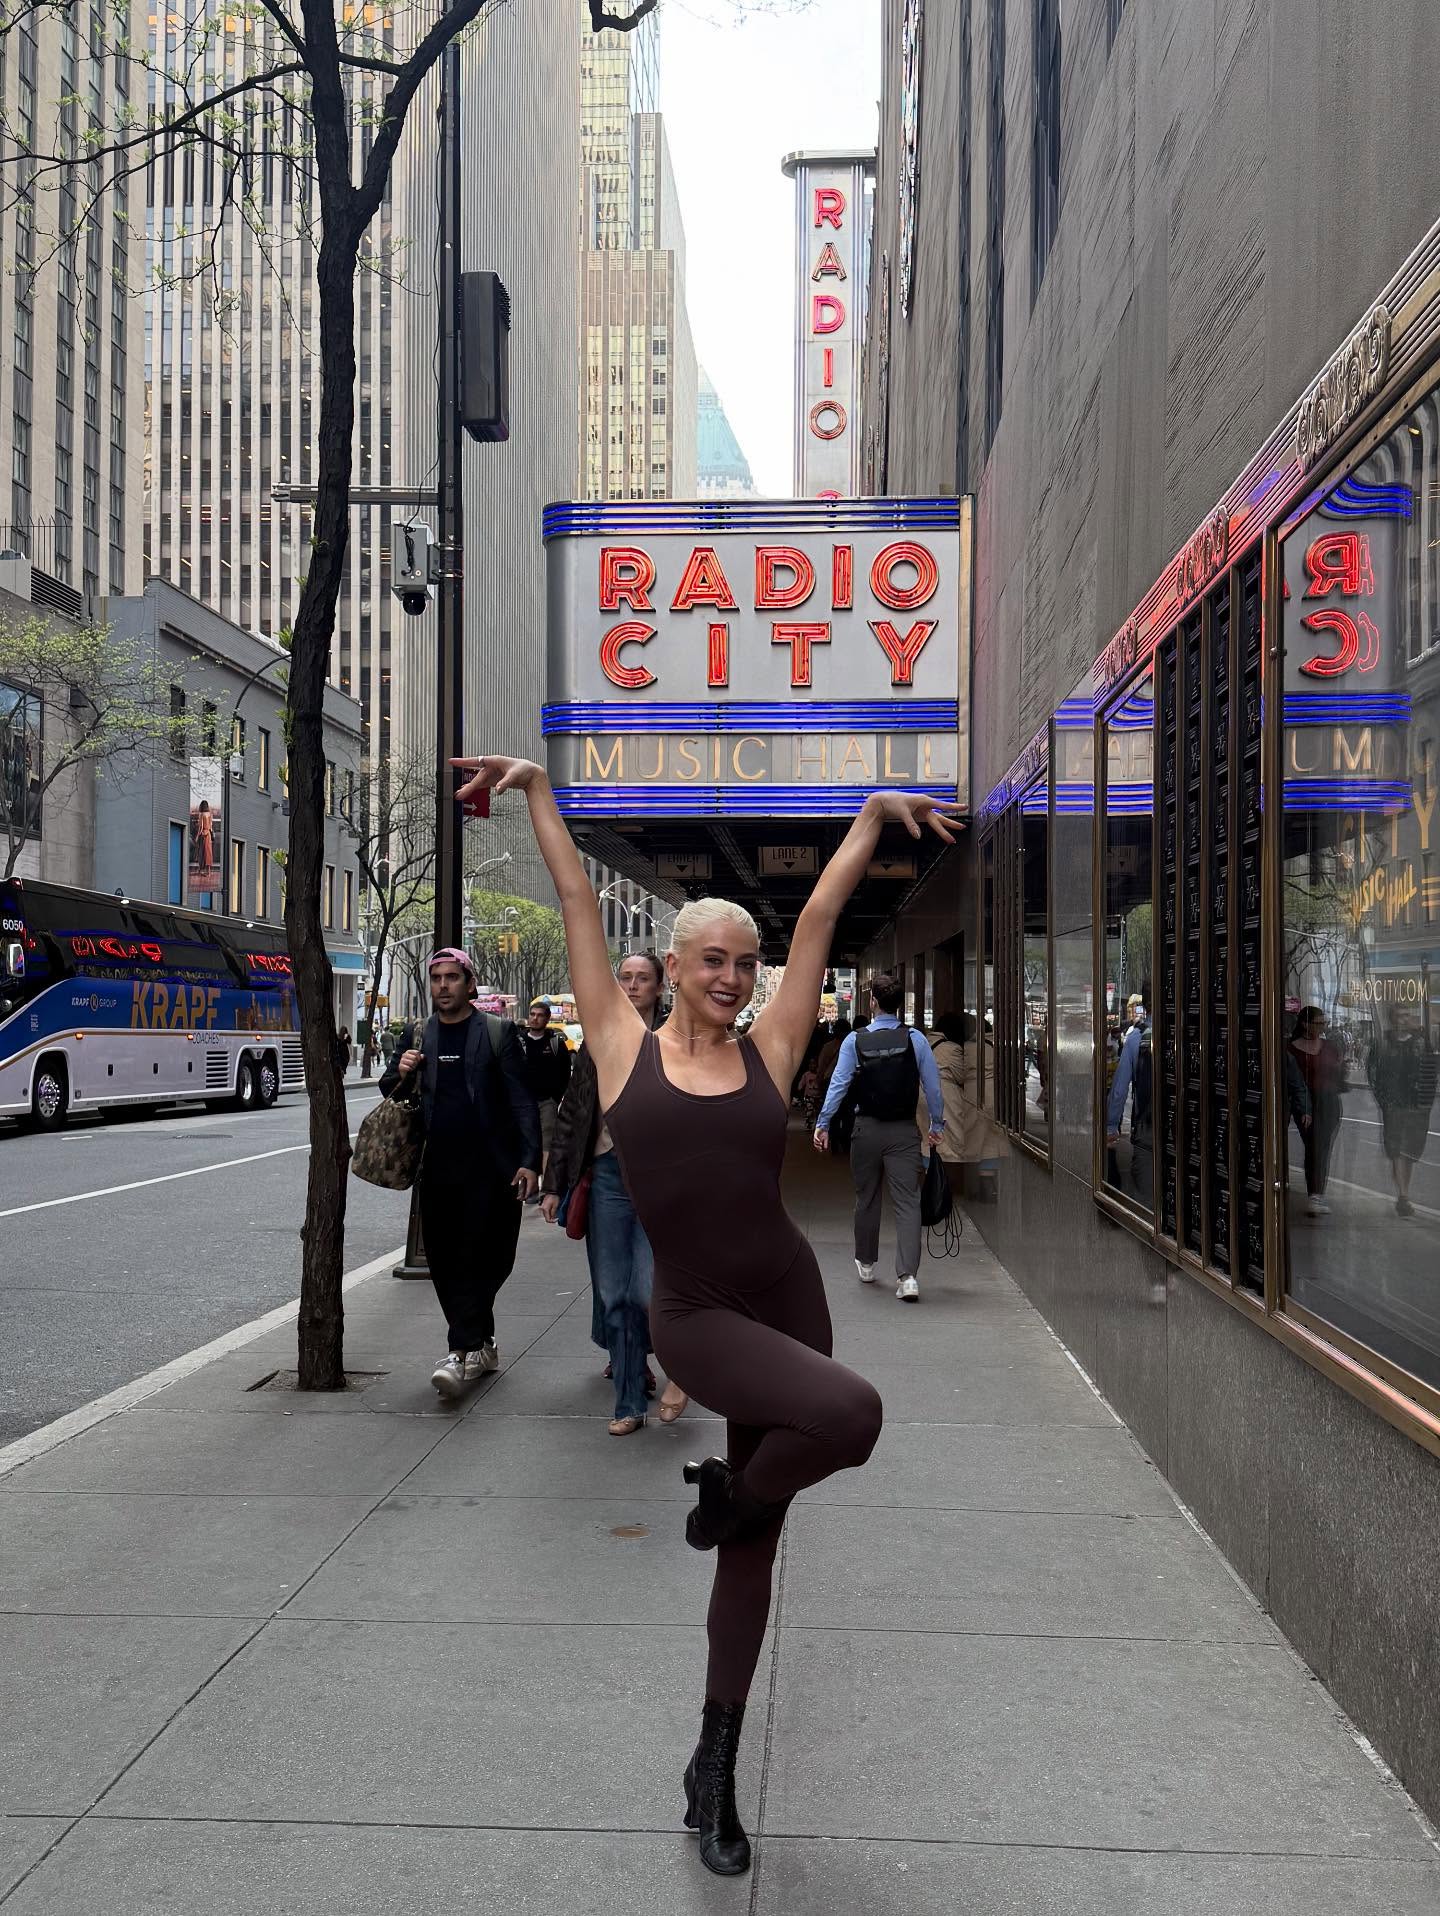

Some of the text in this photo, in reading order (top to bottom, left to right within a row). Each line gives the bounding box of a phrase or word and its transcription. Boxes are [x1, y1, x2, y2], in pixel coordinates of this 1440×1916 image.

[809, 187, 847, 440] RADIO
[599, 539, 940, 612] RADIO
[599, 619, 940, 691] CITY
[584, 734, 950, 782] MUSIC HALL
[772, 847, 807, 860] LANE 2
[2, 918, 24, 931] 6050
[130, 980, 222, 1030] KRAPF
[192, 1032, 220, 1044] COACHES
